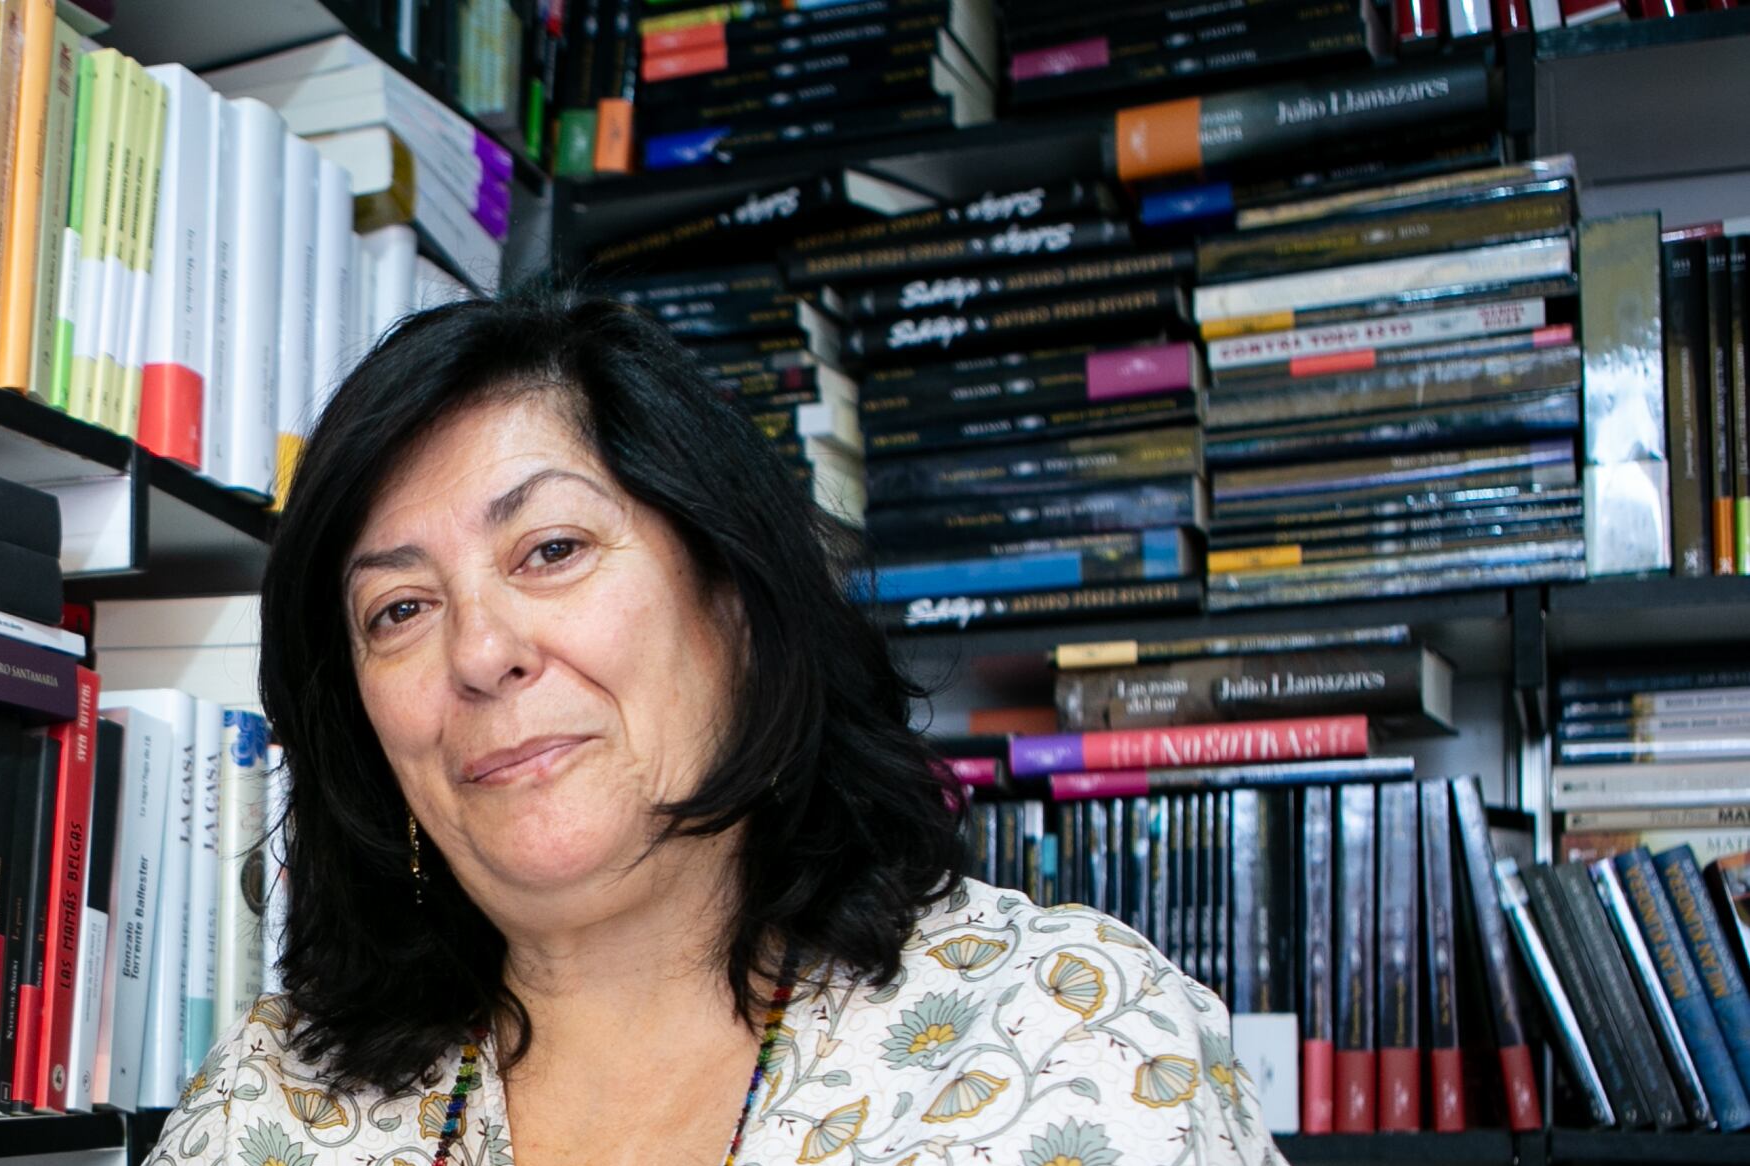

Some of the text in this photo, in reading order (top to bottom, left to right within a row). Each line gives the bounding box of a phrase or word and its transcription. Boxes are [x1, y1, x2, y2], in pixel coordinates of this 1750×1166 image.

[1275, 76, 1449, 126] Julio Llamazares
[12, 664, 58, 688] SANTAMARÍA
[1220, 676, 1266, 701] Julio
[1271, 669, 1386, 699] Llamazares
[77, 736, 88, 763] SVEN
[180, 744, 195, 844] LA CASA
[203, 751, 221, 851] LA CASA
[68, 822, 83, 881] BELGAS
[62, 891, 76, 950] MAMÁS
[130, 854, 149, 980] Torrente Ballester
[61, 962, 72, 989] LAS
[122, 921, 134, 978] Gonzalo
